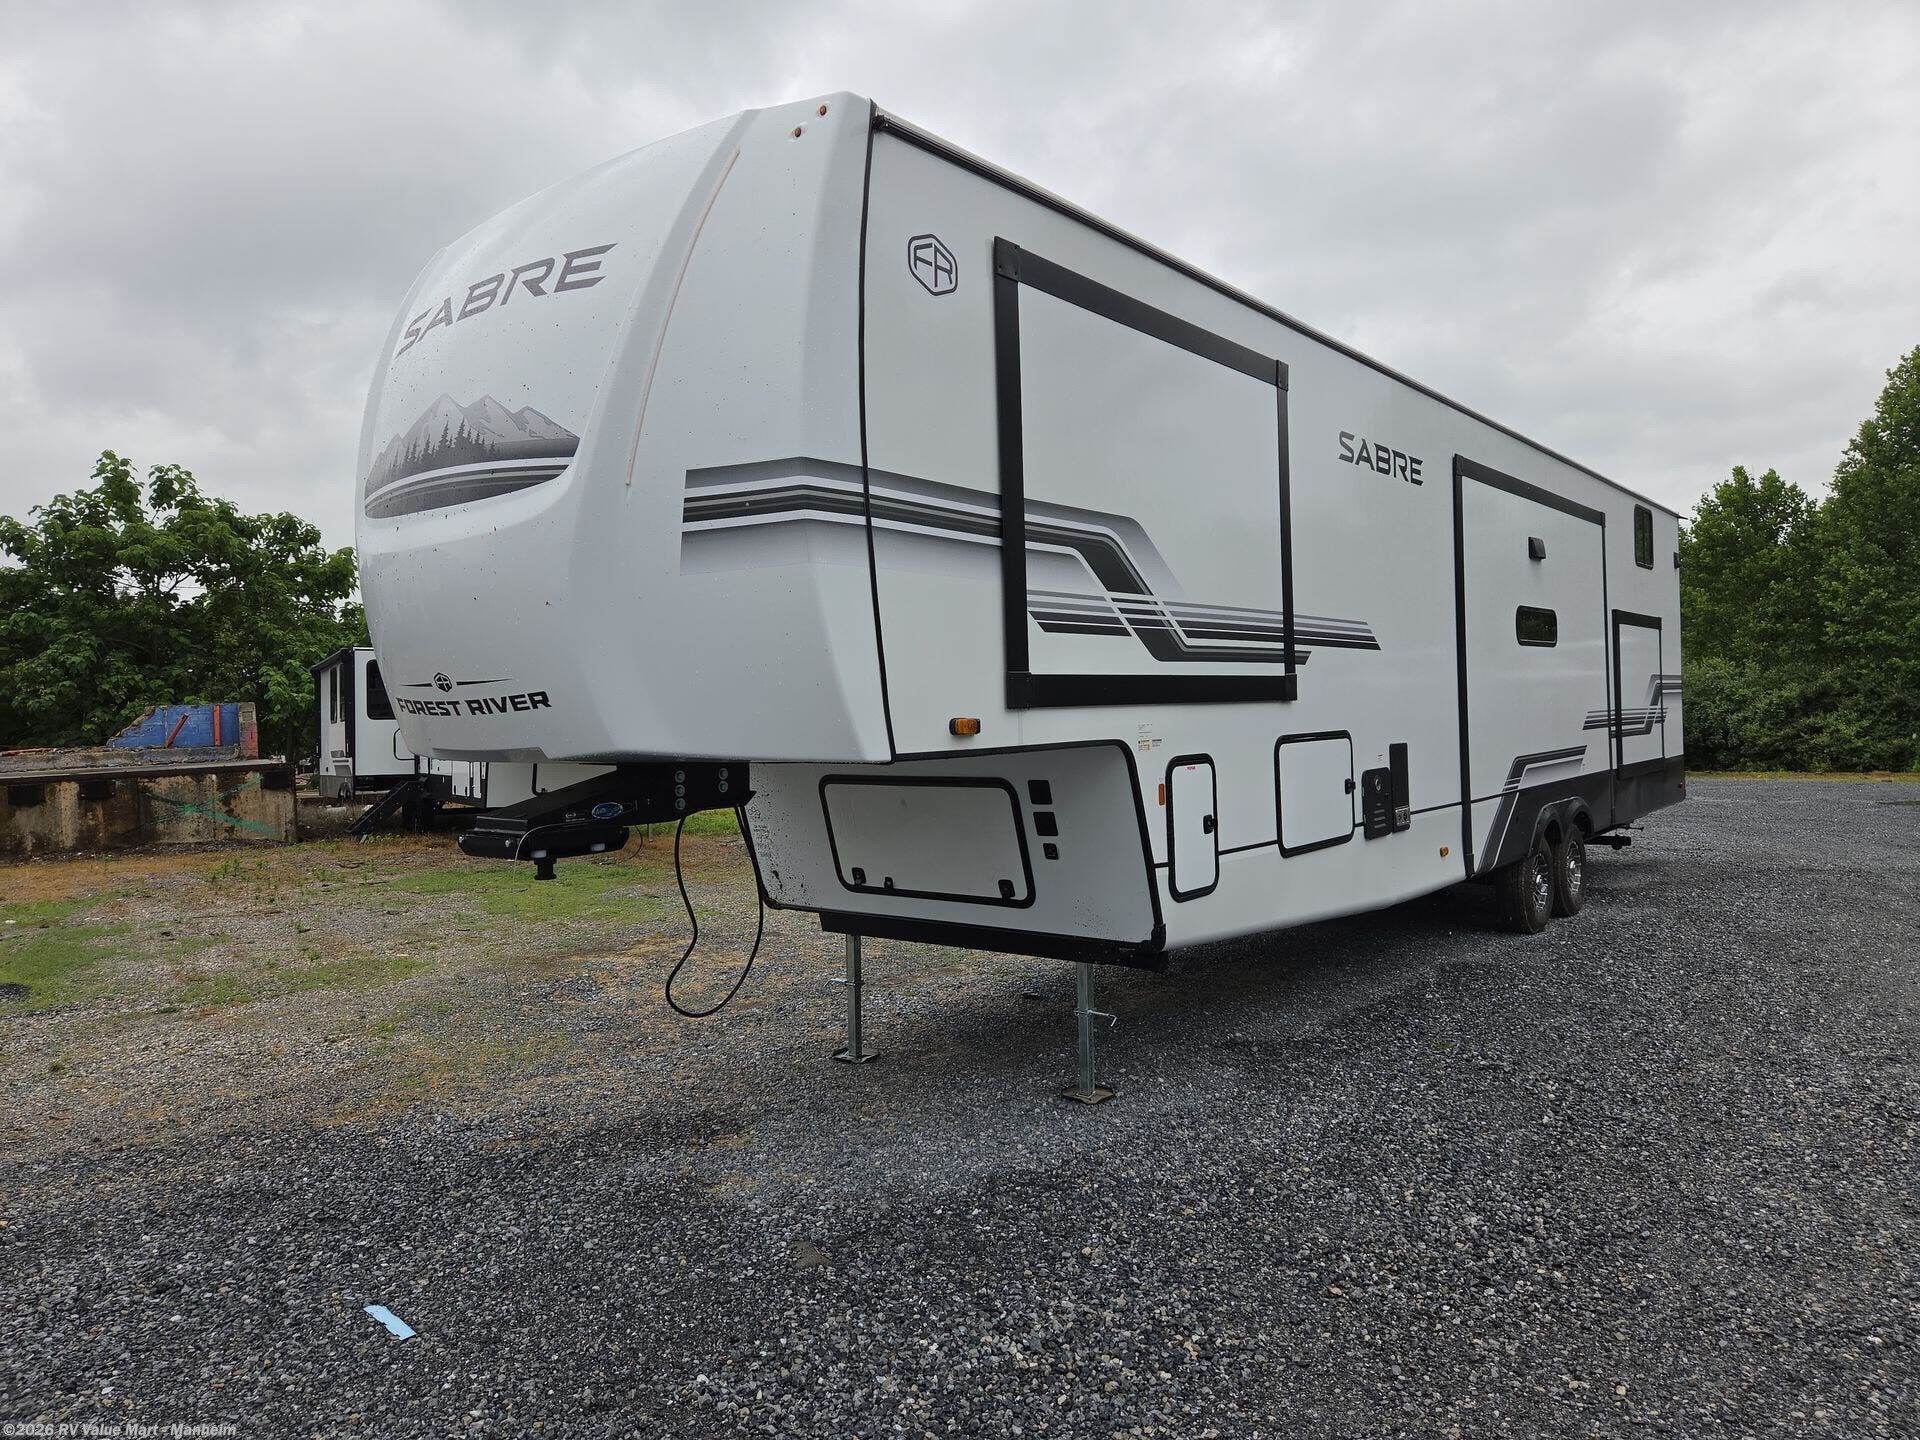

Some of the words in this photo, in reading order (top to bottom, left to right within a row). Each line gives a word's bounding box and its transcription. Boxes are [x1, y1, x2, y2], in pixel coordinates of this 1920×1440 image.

[394, 242, 618, 360] SABRE
[1338, 430, 1424, 486] SABRE
[396, 697, 462, 717] FOREST
[464, 691, 552, 716] RIVER
